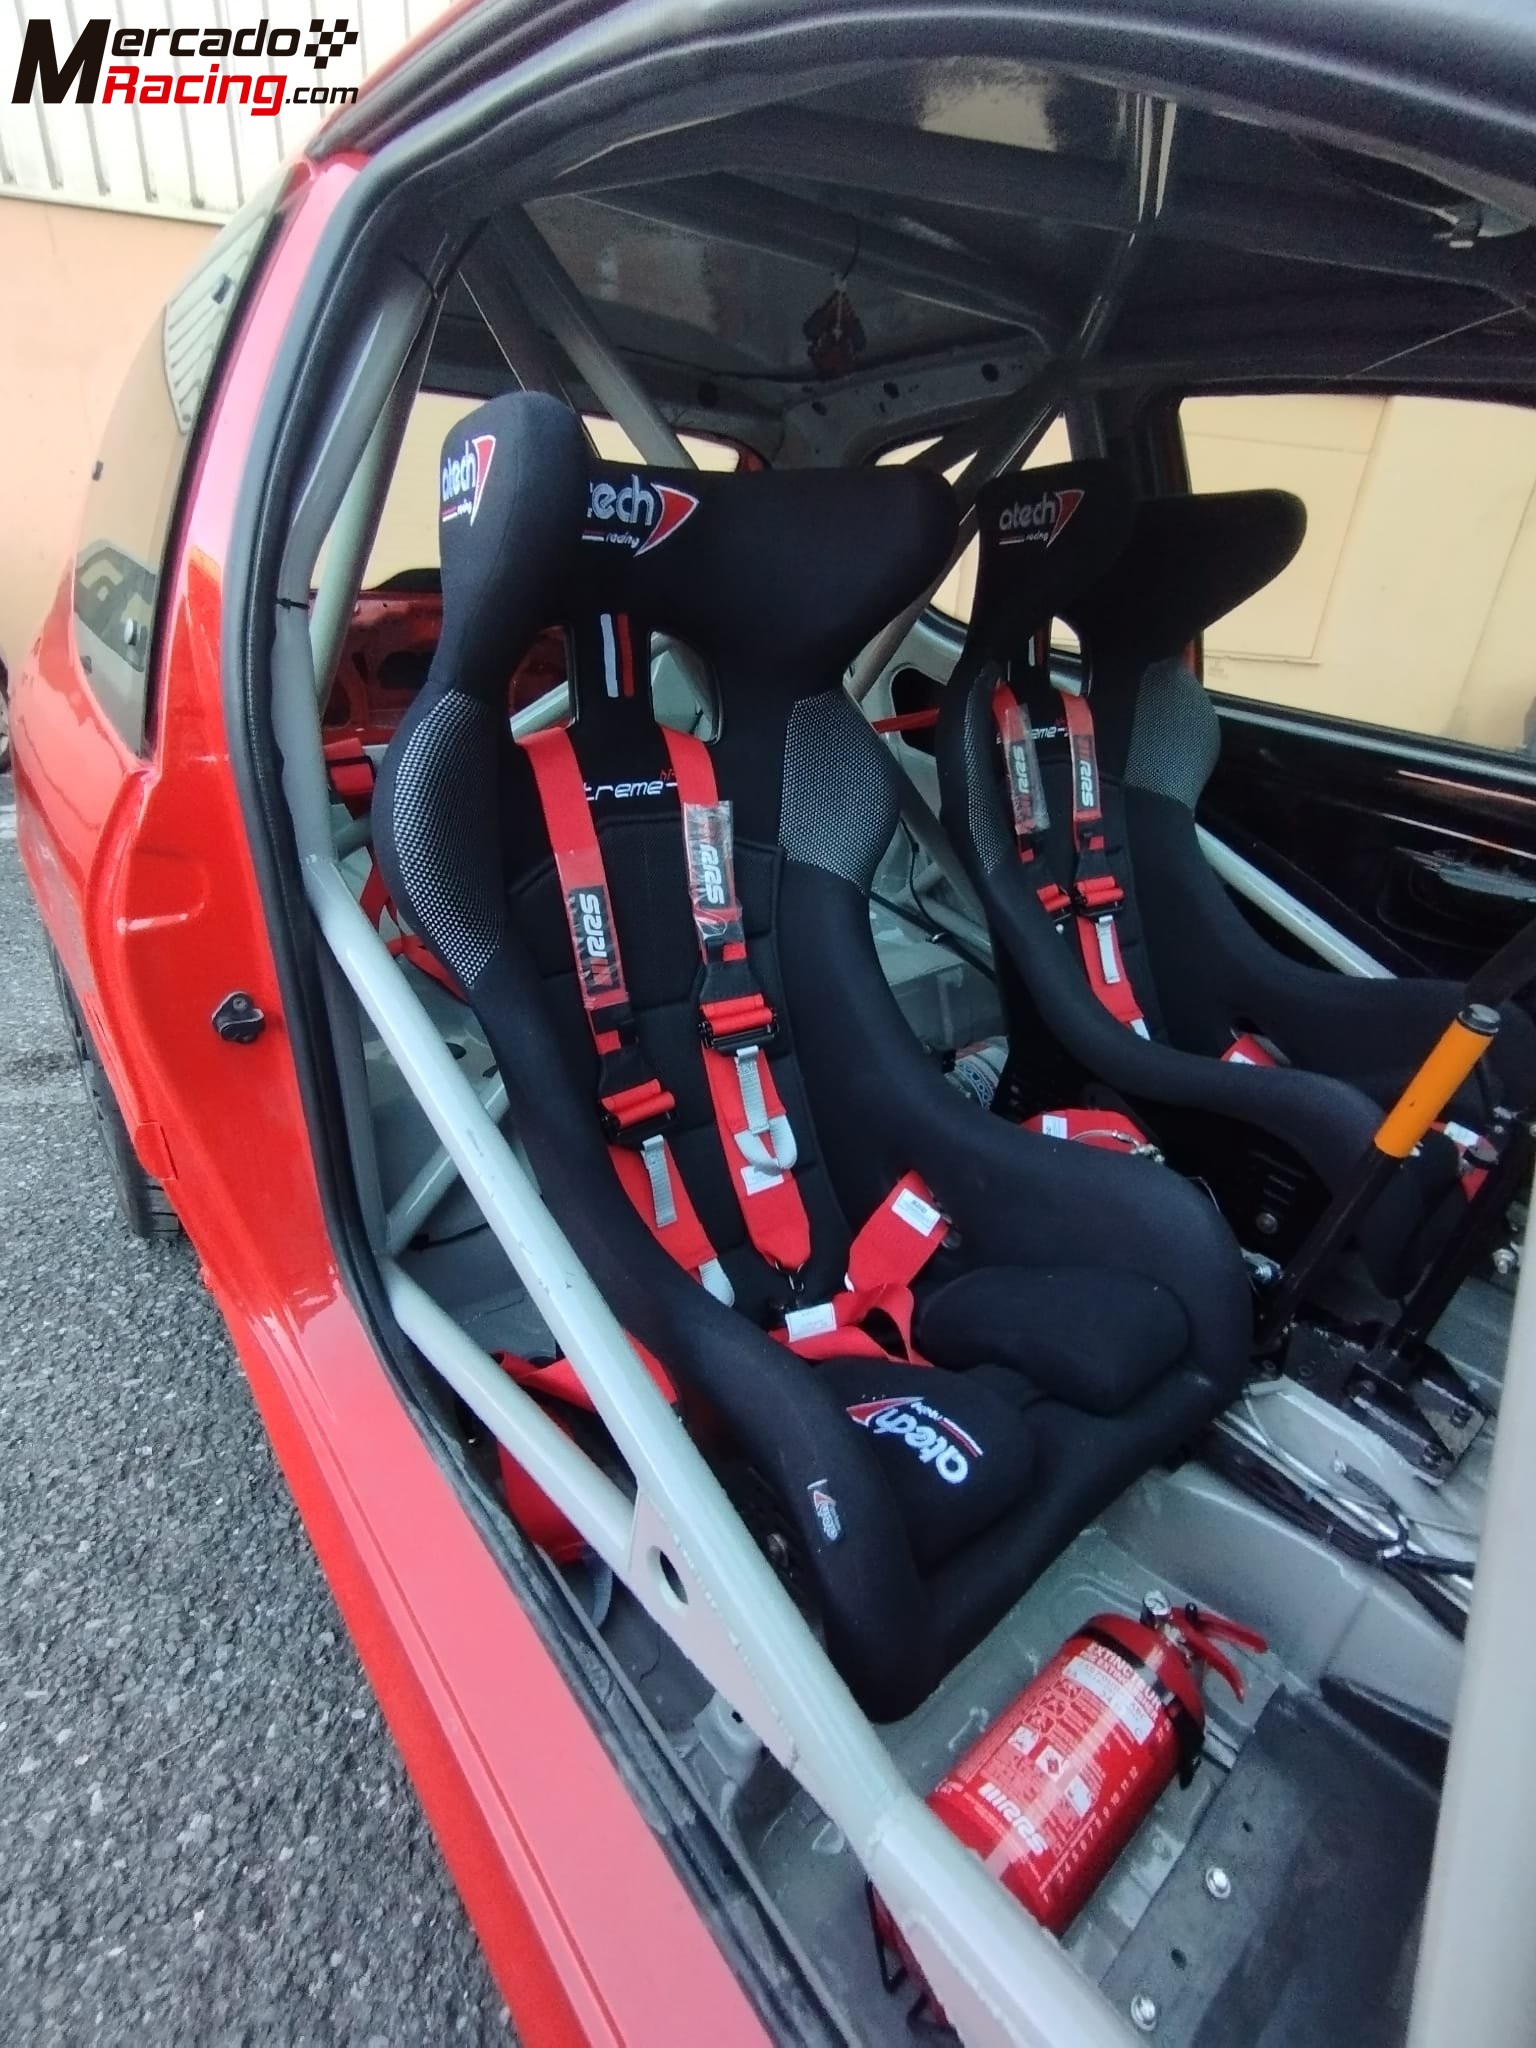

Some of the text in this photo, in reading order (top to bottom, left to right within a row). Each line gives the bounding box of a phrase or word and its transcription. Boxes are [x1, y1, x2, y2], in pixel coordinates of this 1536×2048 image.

[442, 440, 476, 501] atech
[999, 492, 1056, 530] atech
[605, 532, 640, 548] racing
[1012, 745, 1029, 794] RRS
[1079, 760, 1094, 807] RRS
[579, 893, 607, 957] RRS
[874, 1408, 969, 1484] atech
[1087, 1640, 1162, 1711] EXTINCTEUR
